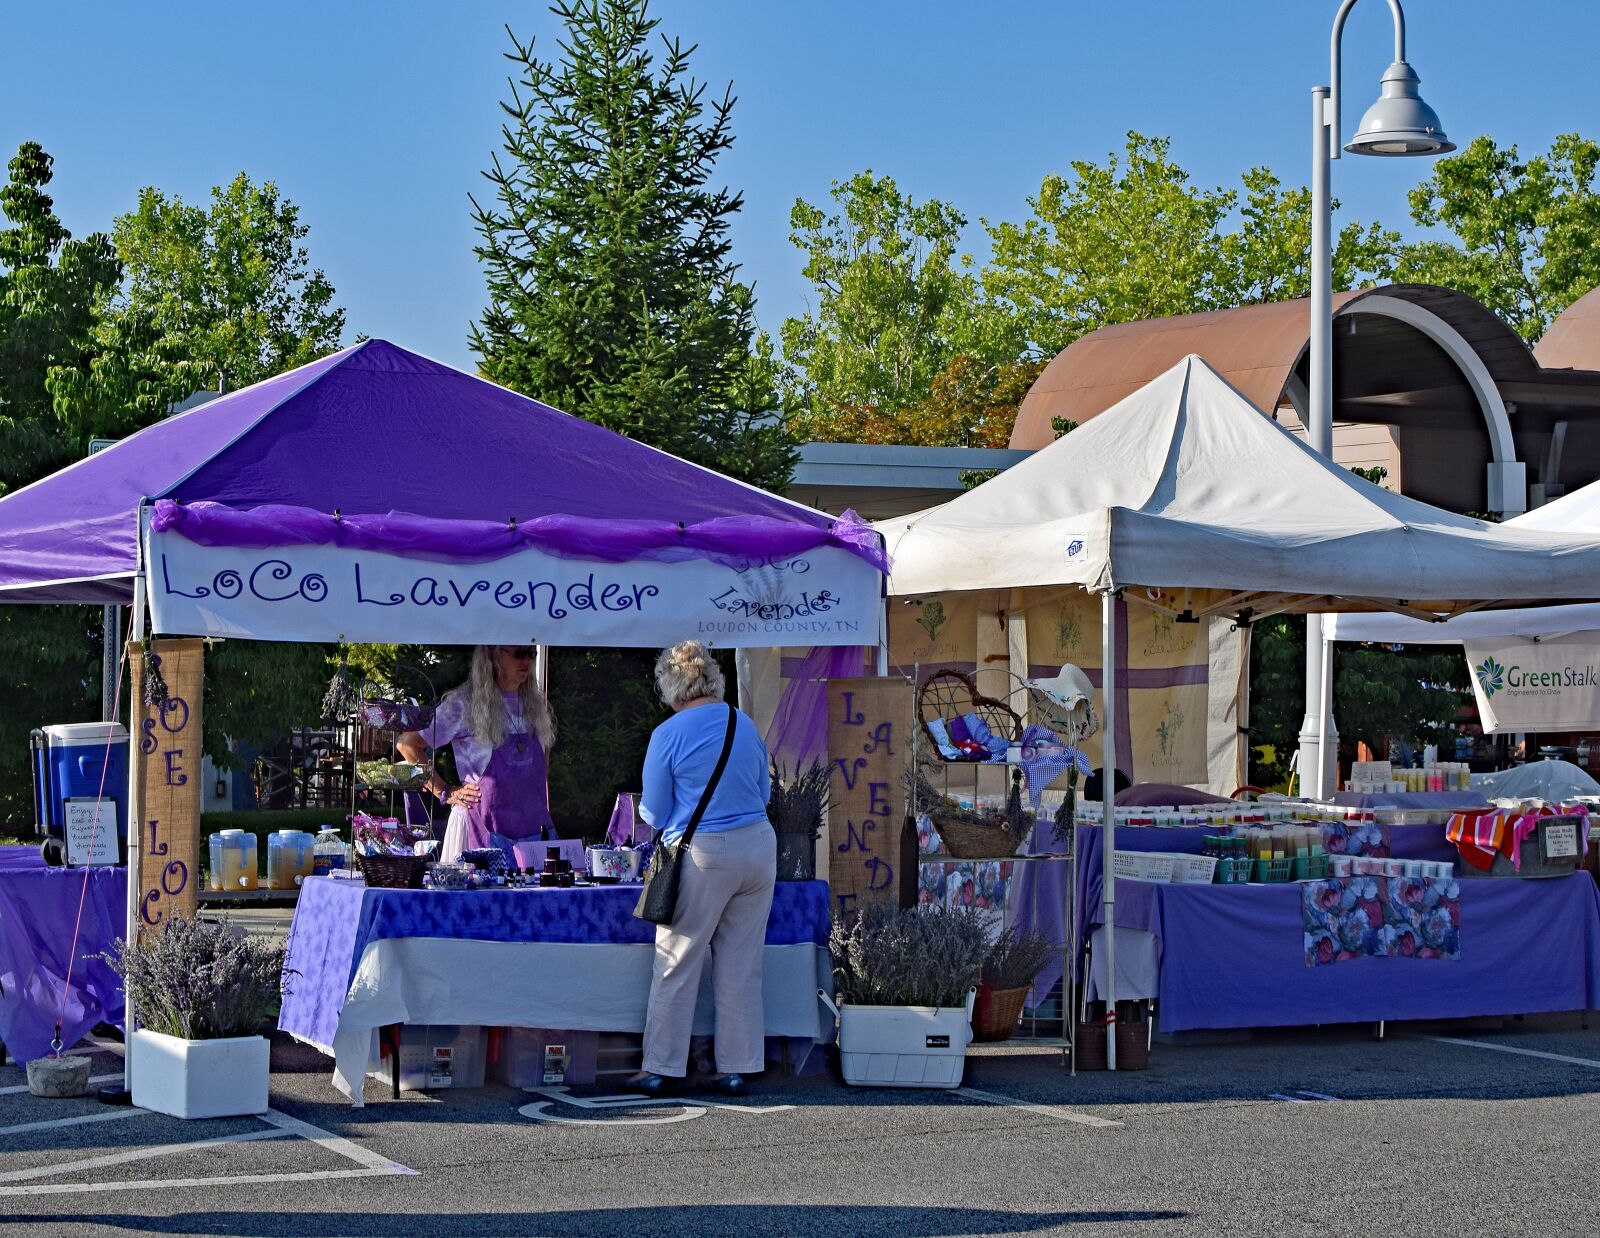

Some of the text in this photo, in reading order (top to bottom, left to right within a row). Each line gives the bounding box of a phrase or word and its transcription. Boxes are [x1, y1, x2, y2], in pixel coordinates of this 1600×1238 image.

[162, 553, 659, 620] LoCo Lavender
[709, 586, 840, 621] Lavender
[698, 620, 859, 633] LOUDON COUNTY, TN
[1507, 689, 1539, 697] Engineered
